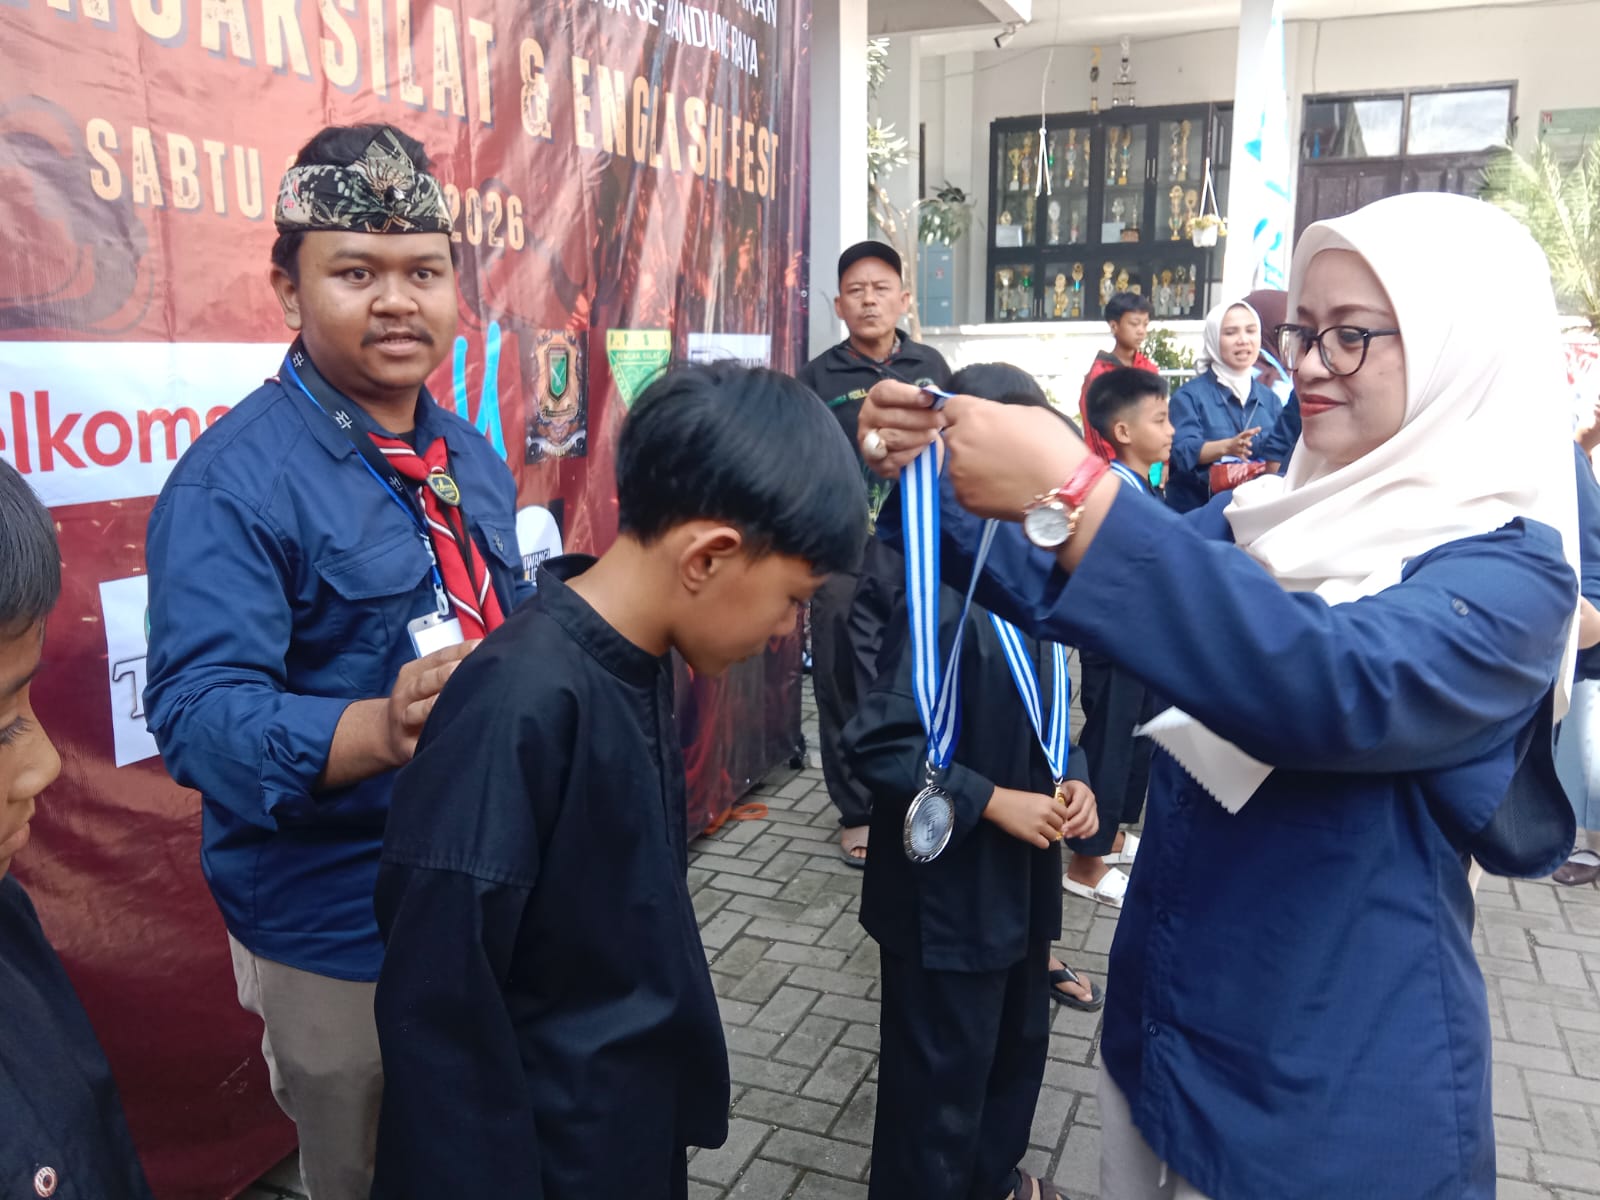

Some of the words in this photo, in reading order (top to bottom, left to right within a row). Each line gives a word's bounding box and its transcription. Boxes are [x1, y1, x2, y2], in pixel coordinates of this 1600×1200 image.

[731, 26, 759, 77] RAYA
[519, 37, 553, 139] &
[572, 55, 724, 182] ENGLISH
[731, 115, 779, 200] FEST
[85, 117, 264, 220] SABTU
[443, 183, 525, 251] 2026
[0, 390, 232, 475] lkom
